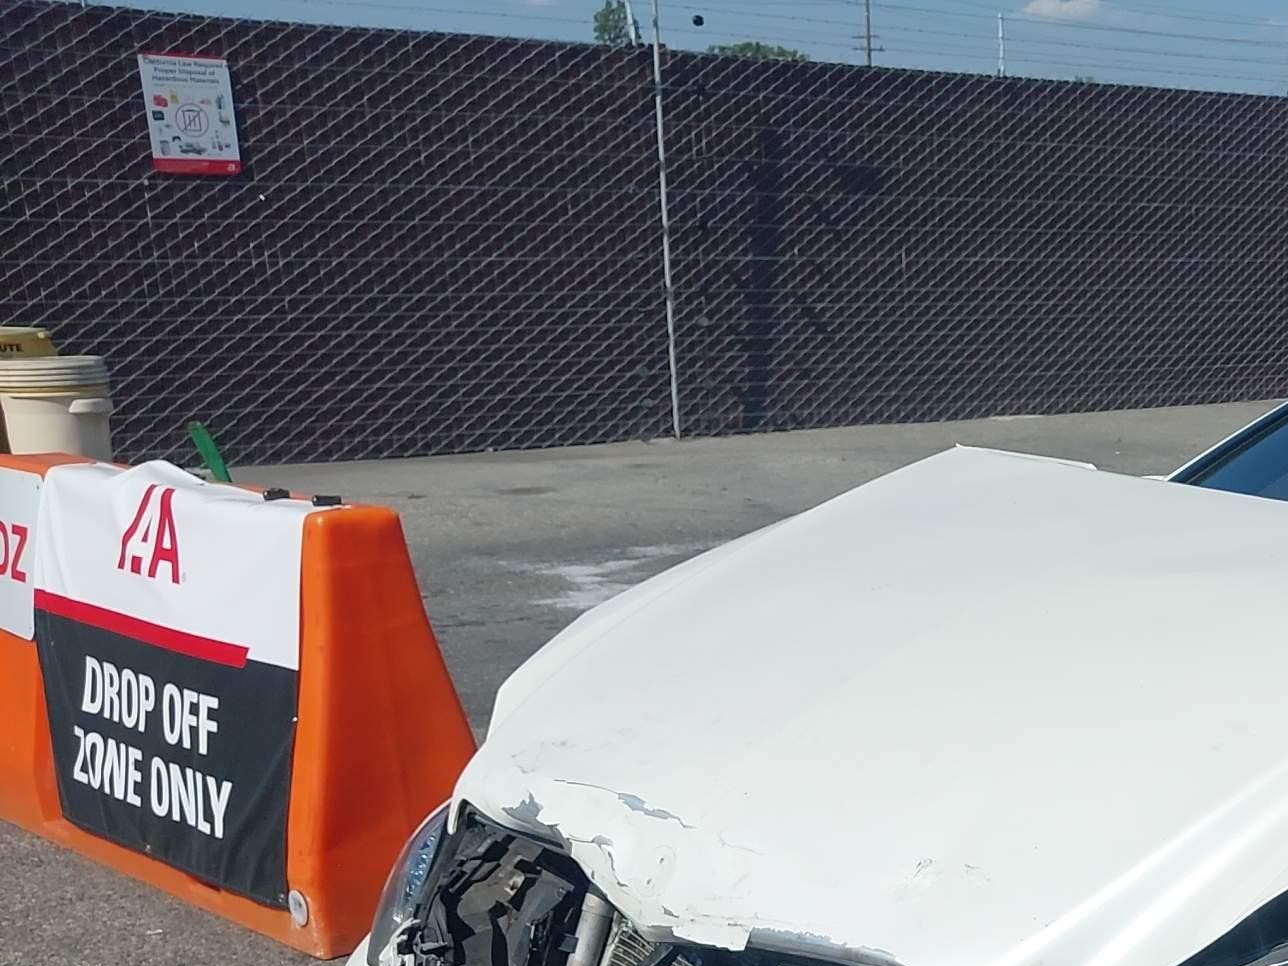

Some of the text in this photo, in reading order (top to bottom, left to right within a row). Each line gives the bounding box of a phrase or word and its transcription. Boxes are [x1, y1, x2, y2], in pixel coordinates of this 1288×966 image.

[81, 655, 219, 755] DROP OFF
[73, 725, 233, 839] ZONE ONLY
